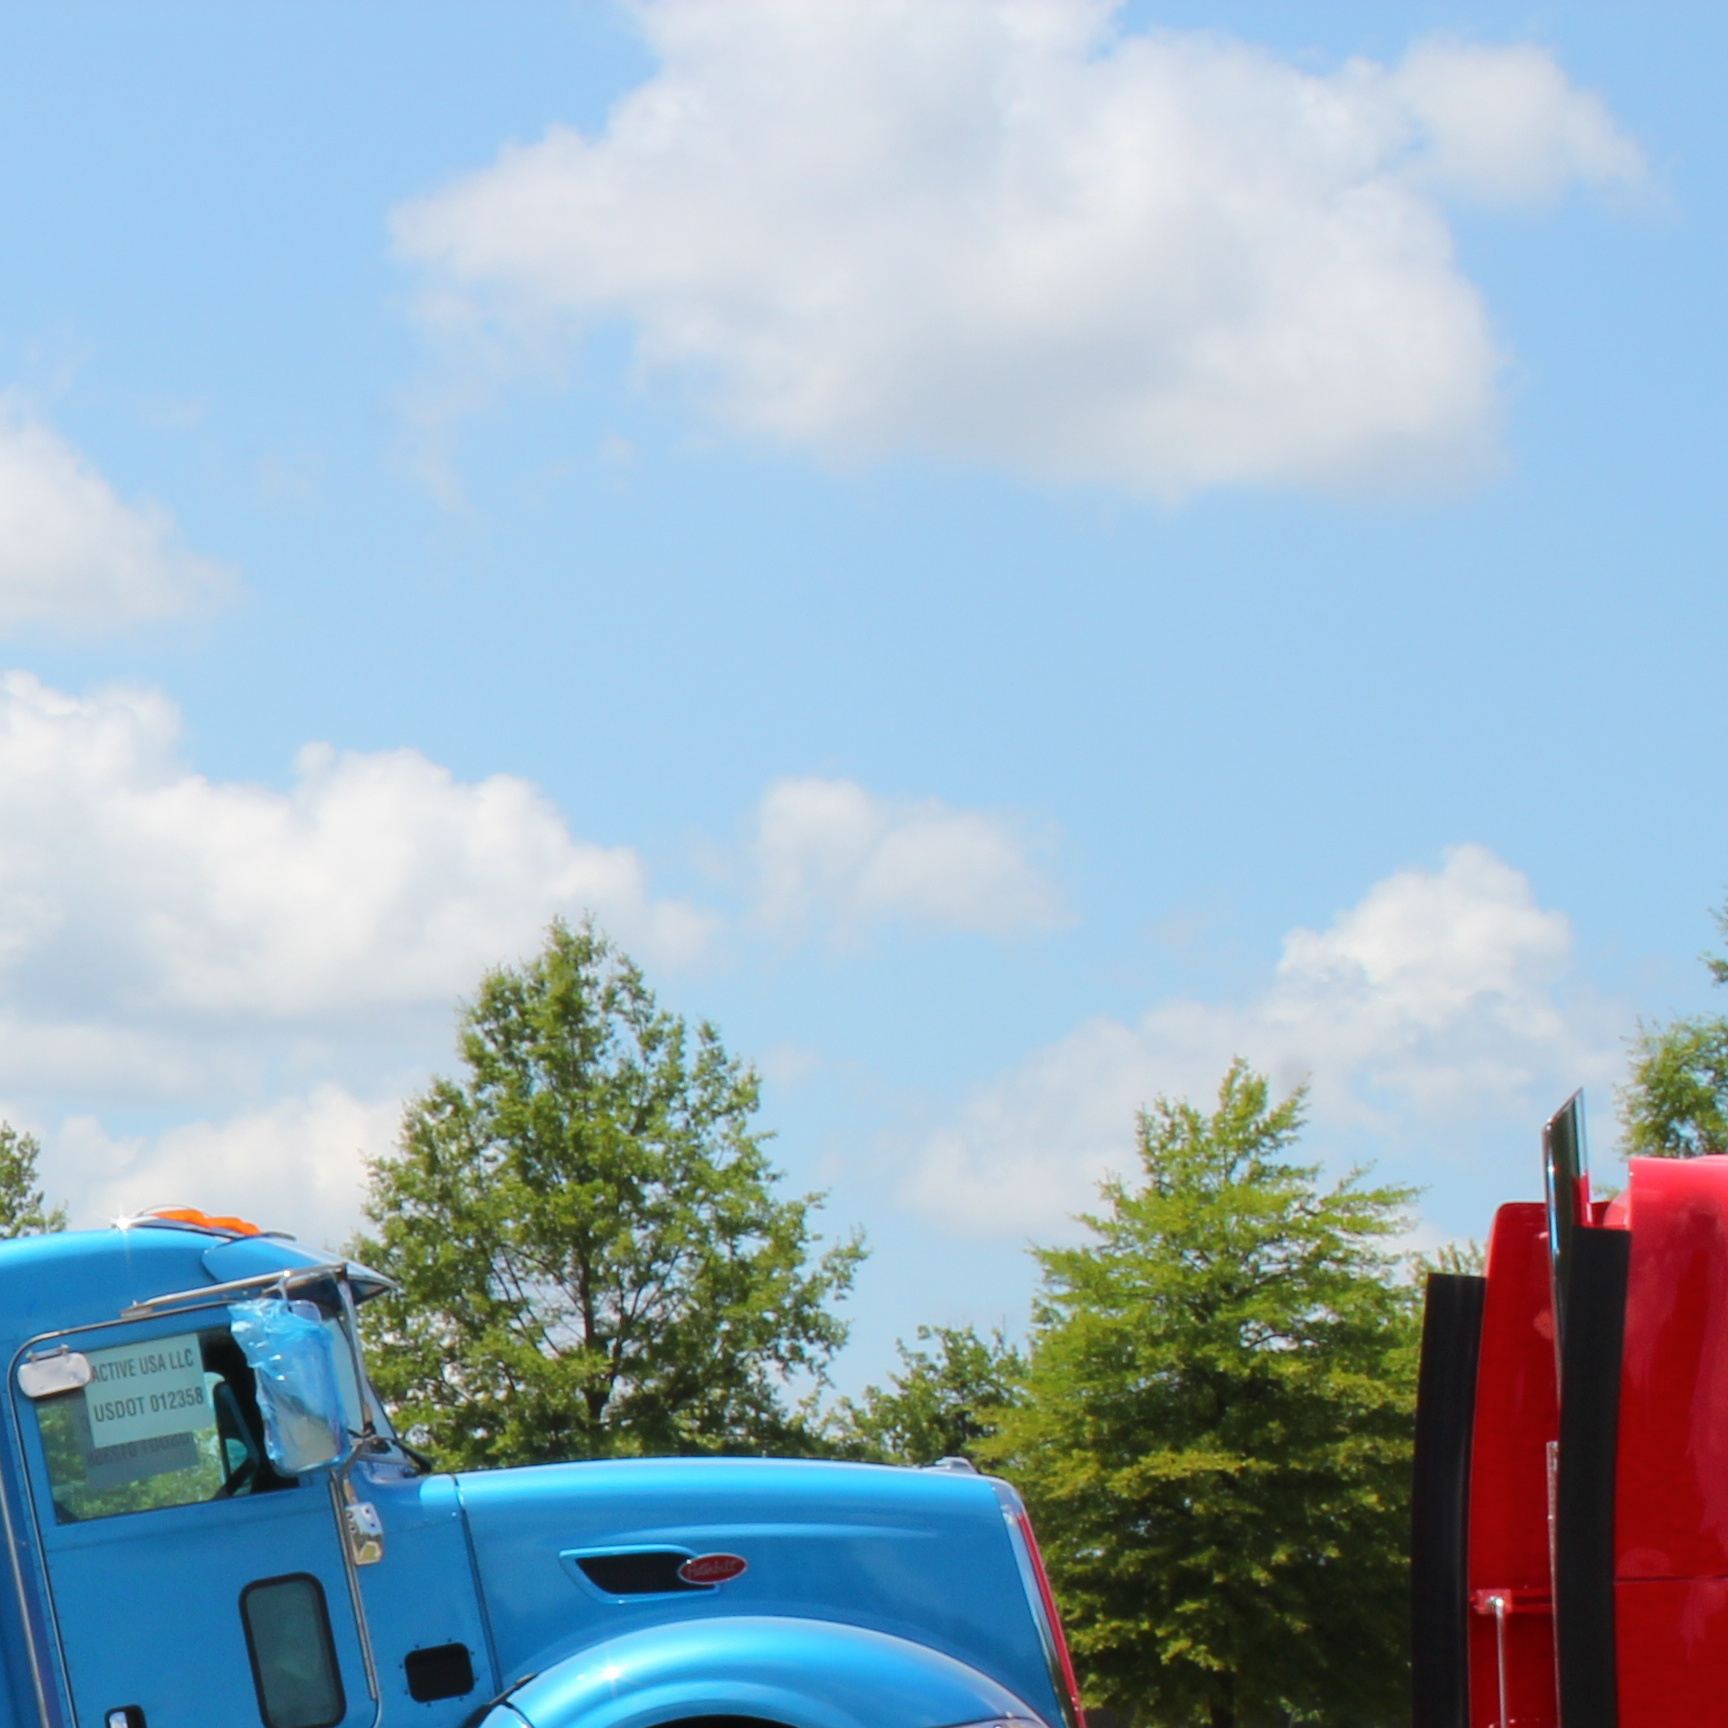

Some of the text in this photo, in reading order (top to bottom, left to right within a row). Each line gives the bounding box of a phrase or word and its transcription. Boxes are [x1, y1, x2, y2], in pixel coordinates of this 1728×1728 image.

[91, 1348, 194, 1382] ACTIVE USA LLC
[94, 1386, 204, 1422] USDOT 012358
